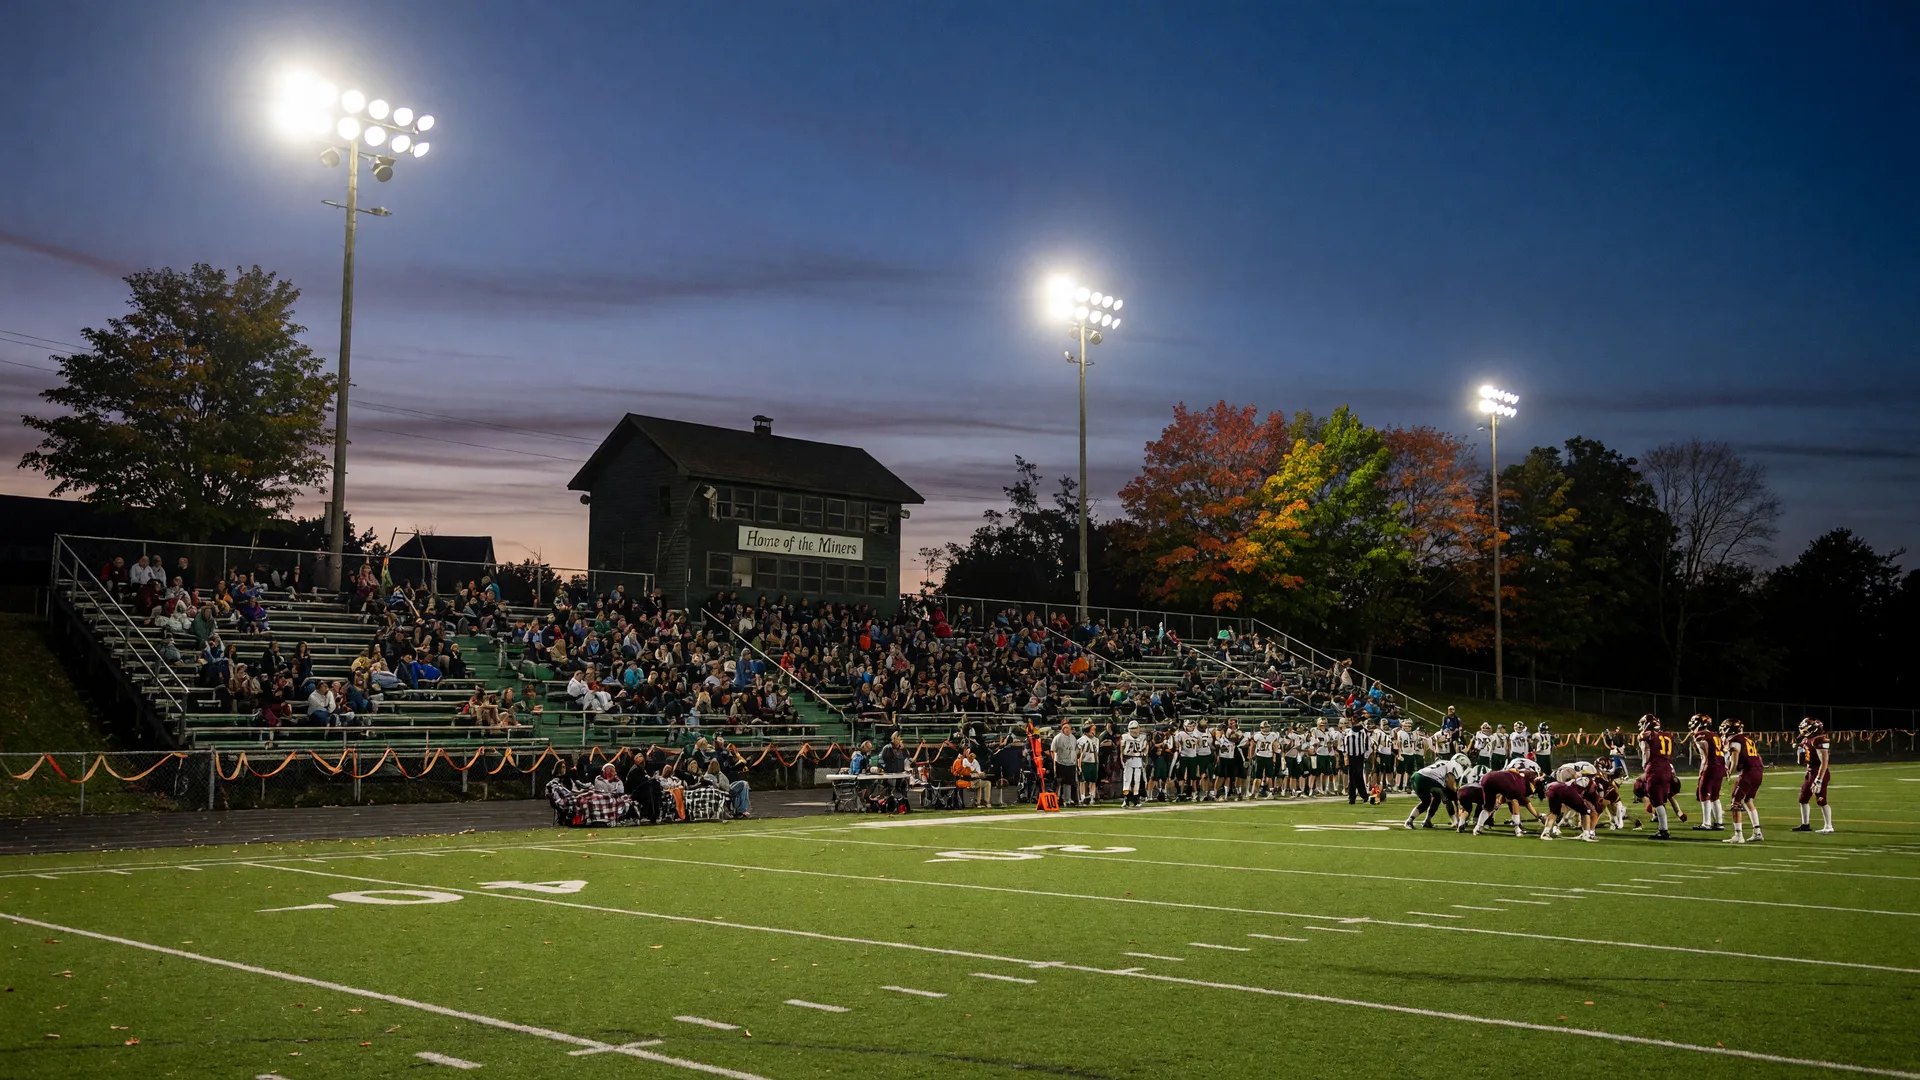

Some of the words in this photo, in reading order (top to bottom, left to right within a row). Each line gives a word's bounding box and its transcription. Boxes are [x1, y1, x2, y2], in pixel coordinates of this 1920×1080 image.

[746, 530, 780, 548] Home
[783, 535, 796, 553] of
[798, 535, 814, 551] the
[818, 537, 857, 555] Miners
[1046, 794, 1057, 809] 10
